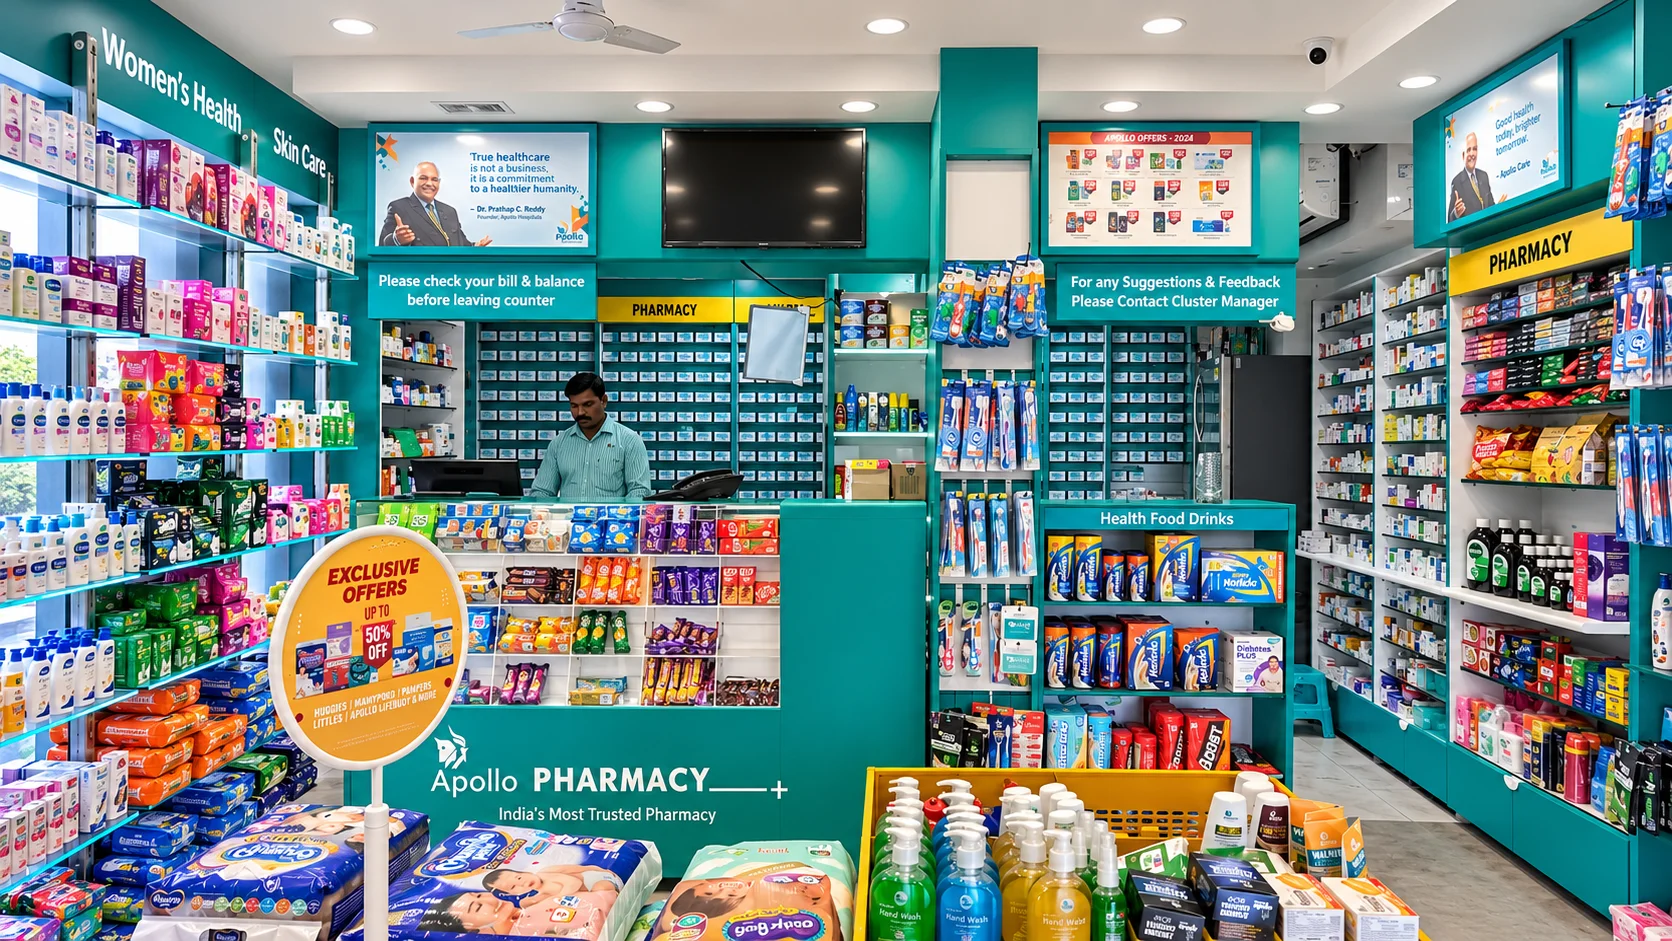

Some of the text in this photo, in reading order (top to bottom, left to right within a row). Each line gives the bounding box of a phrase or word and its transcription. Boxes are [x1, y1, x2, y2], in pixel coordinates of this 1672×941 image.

[102, 27, 242, 136] Women's Health
[1496, 101, 1534, 130] Good health
[1515, 114, 1541, 133] brighter
[1104, 134, 1136, 143] APOLLO
[1138, 134, 1167, 143] OFFERS
[273, 127, 326, 178] Skin Care
[496, 152, 550, 162] healthcare
[470, 163, 549, 174] is not a business,
[470, 174, 555, 183] it is a commitment
[470, 185, 480, 193] to
[533, 184, 579, 195] humanity.
[1489, 231, 1573, 275] PHARMACY
[379, 274, 585, 291] Please check your bill & balance
[1071, 276, 1280, 291] For any Suggestions & Feedback
[407, 293, 555, 309] before leaving counter
[632, 303, 697, 316] PHARMACY
[1071, 295, 1279, 311] Please Contact Cluster Manager
[1100, 512, 1234, 526] Health Food Drinks
[327, 557, 420, 586] EXCLUSIVE
[342, 579, 407, 604] OFFERS
[364, 604, 390, 620] UP TO
[365, 625, 391, 644] 50%
[368, 644, 388, 661] OFF
[313, 714, 343, 729] LITTLES
[350, 705, 377, 721] APOLLO
[430, 767, 710, 798] Apollo PHARMACY
[499, 807, 716, 825] India's Most Trusted Pharmacy
[967, 915, 988, 924] Wash
